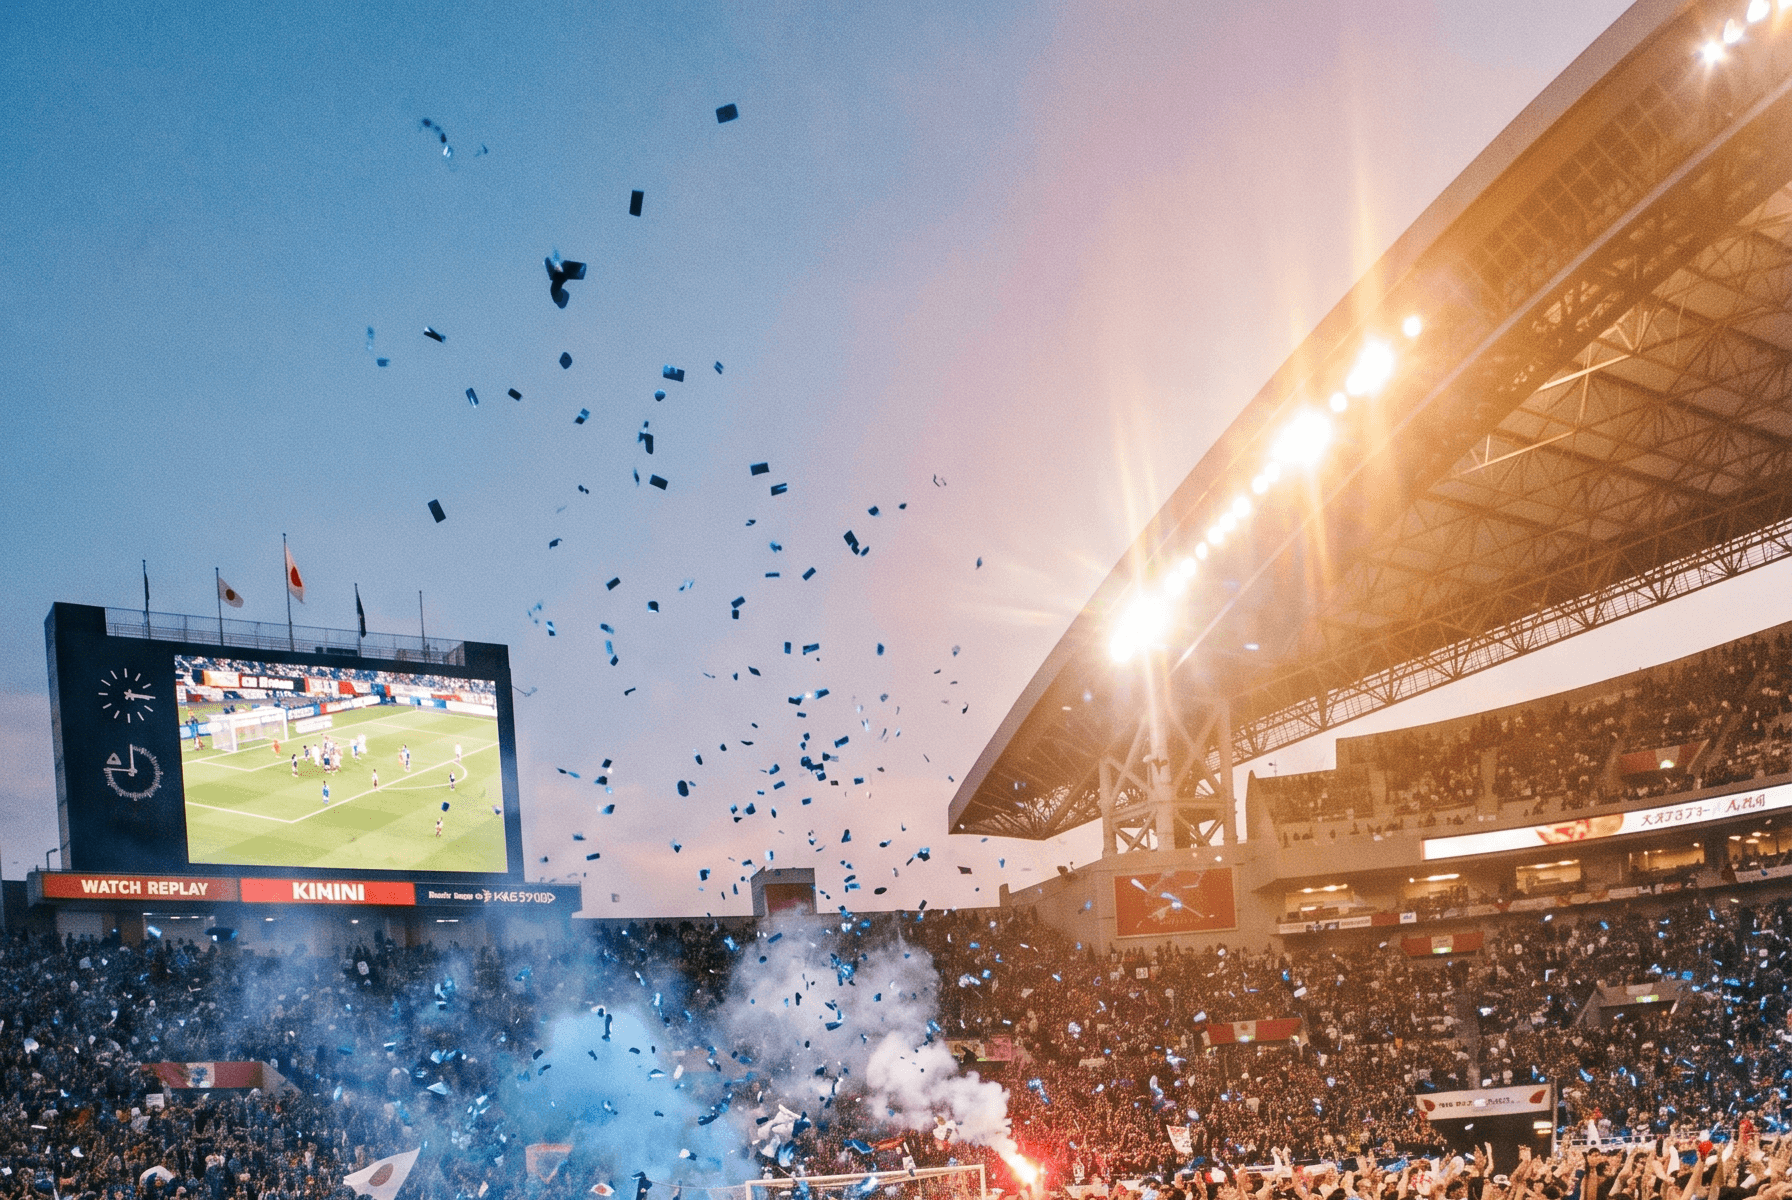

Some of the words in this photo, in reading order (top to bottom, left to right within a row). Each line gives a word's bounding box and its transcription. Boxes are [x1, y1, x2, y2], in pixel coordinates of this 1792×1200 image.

[81, 879, 142, 895] WATCH
[147, 881, 209, 896] REPLAY
[292, 881, 366, 902] KIMINI
